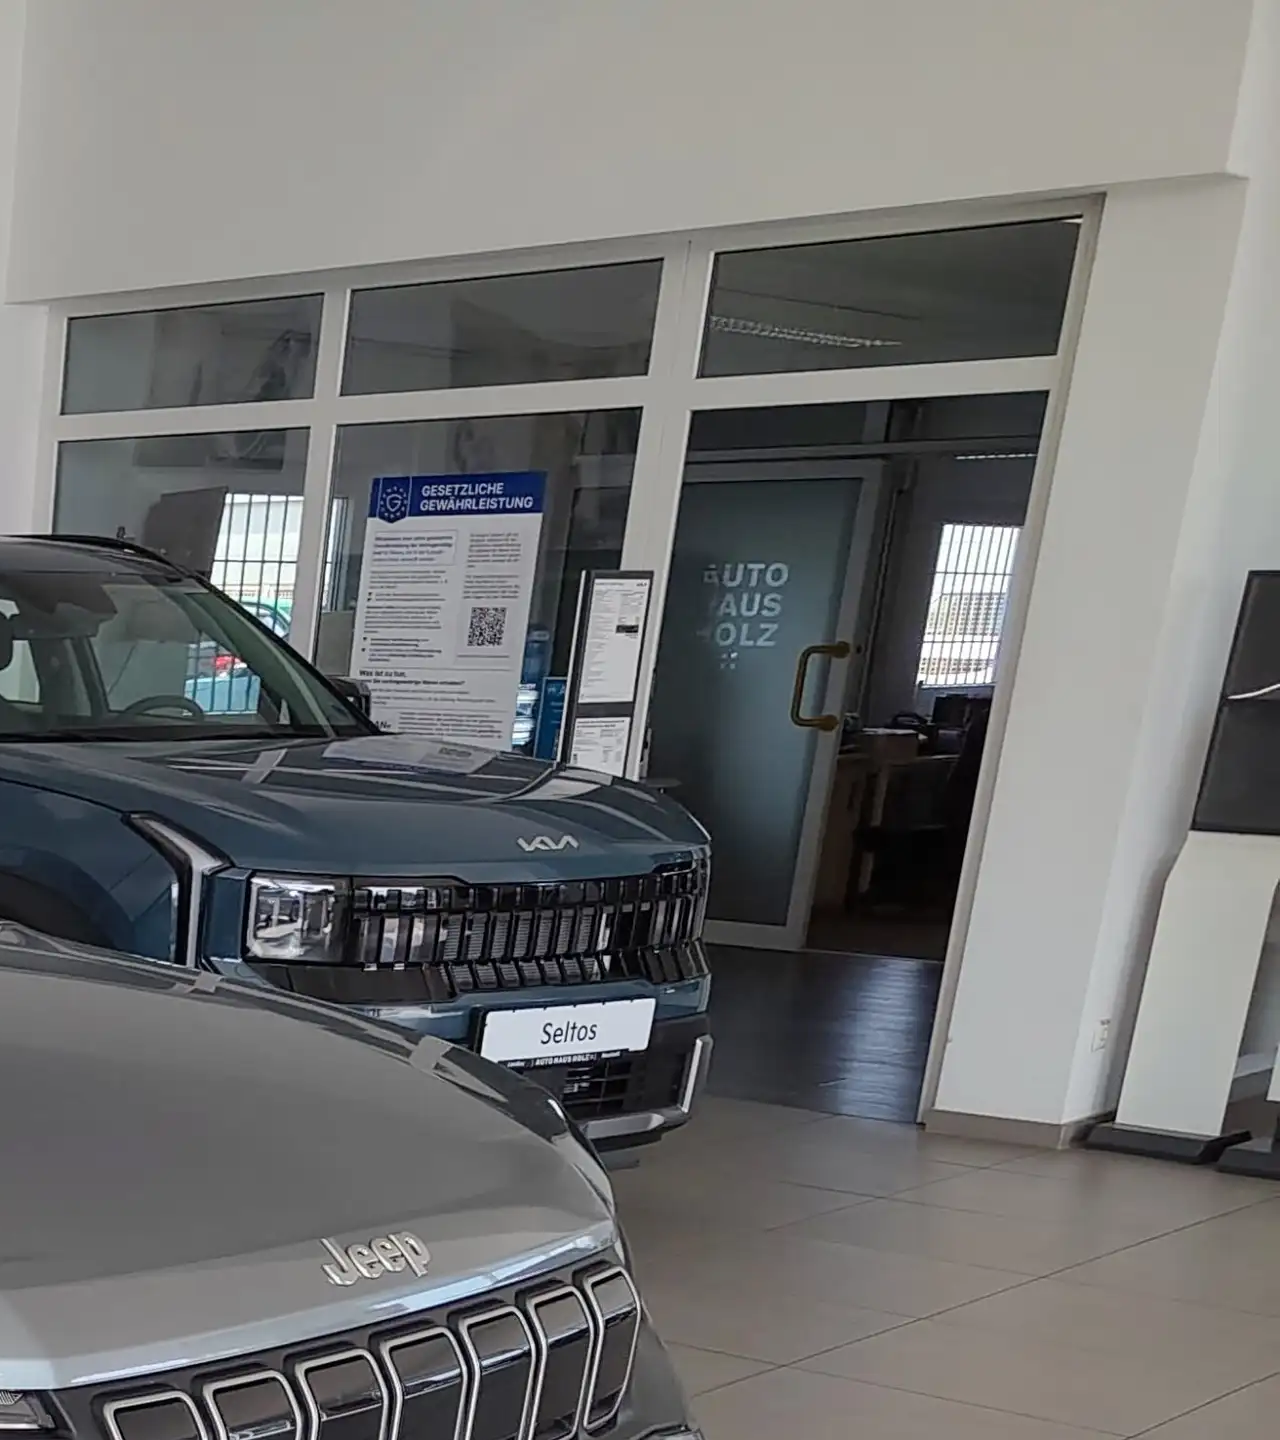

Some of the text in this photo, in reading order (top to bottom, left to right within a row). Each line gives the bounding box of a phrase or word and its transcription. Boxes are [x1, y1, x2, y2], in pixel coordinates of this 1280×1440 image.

[421, 483, 504, 497] GESETZLICHE
[419, 496, 534, 512] GEWÄHRLEISTUNG
[703, 563, 789, 588] AUTO
[717, 592, 783, 617] AUS
[707, 622, 778, 647] OLZ
[541, 1021, 598, 1045] Seltos
[320, 1231, 431, 1287] Jeep
